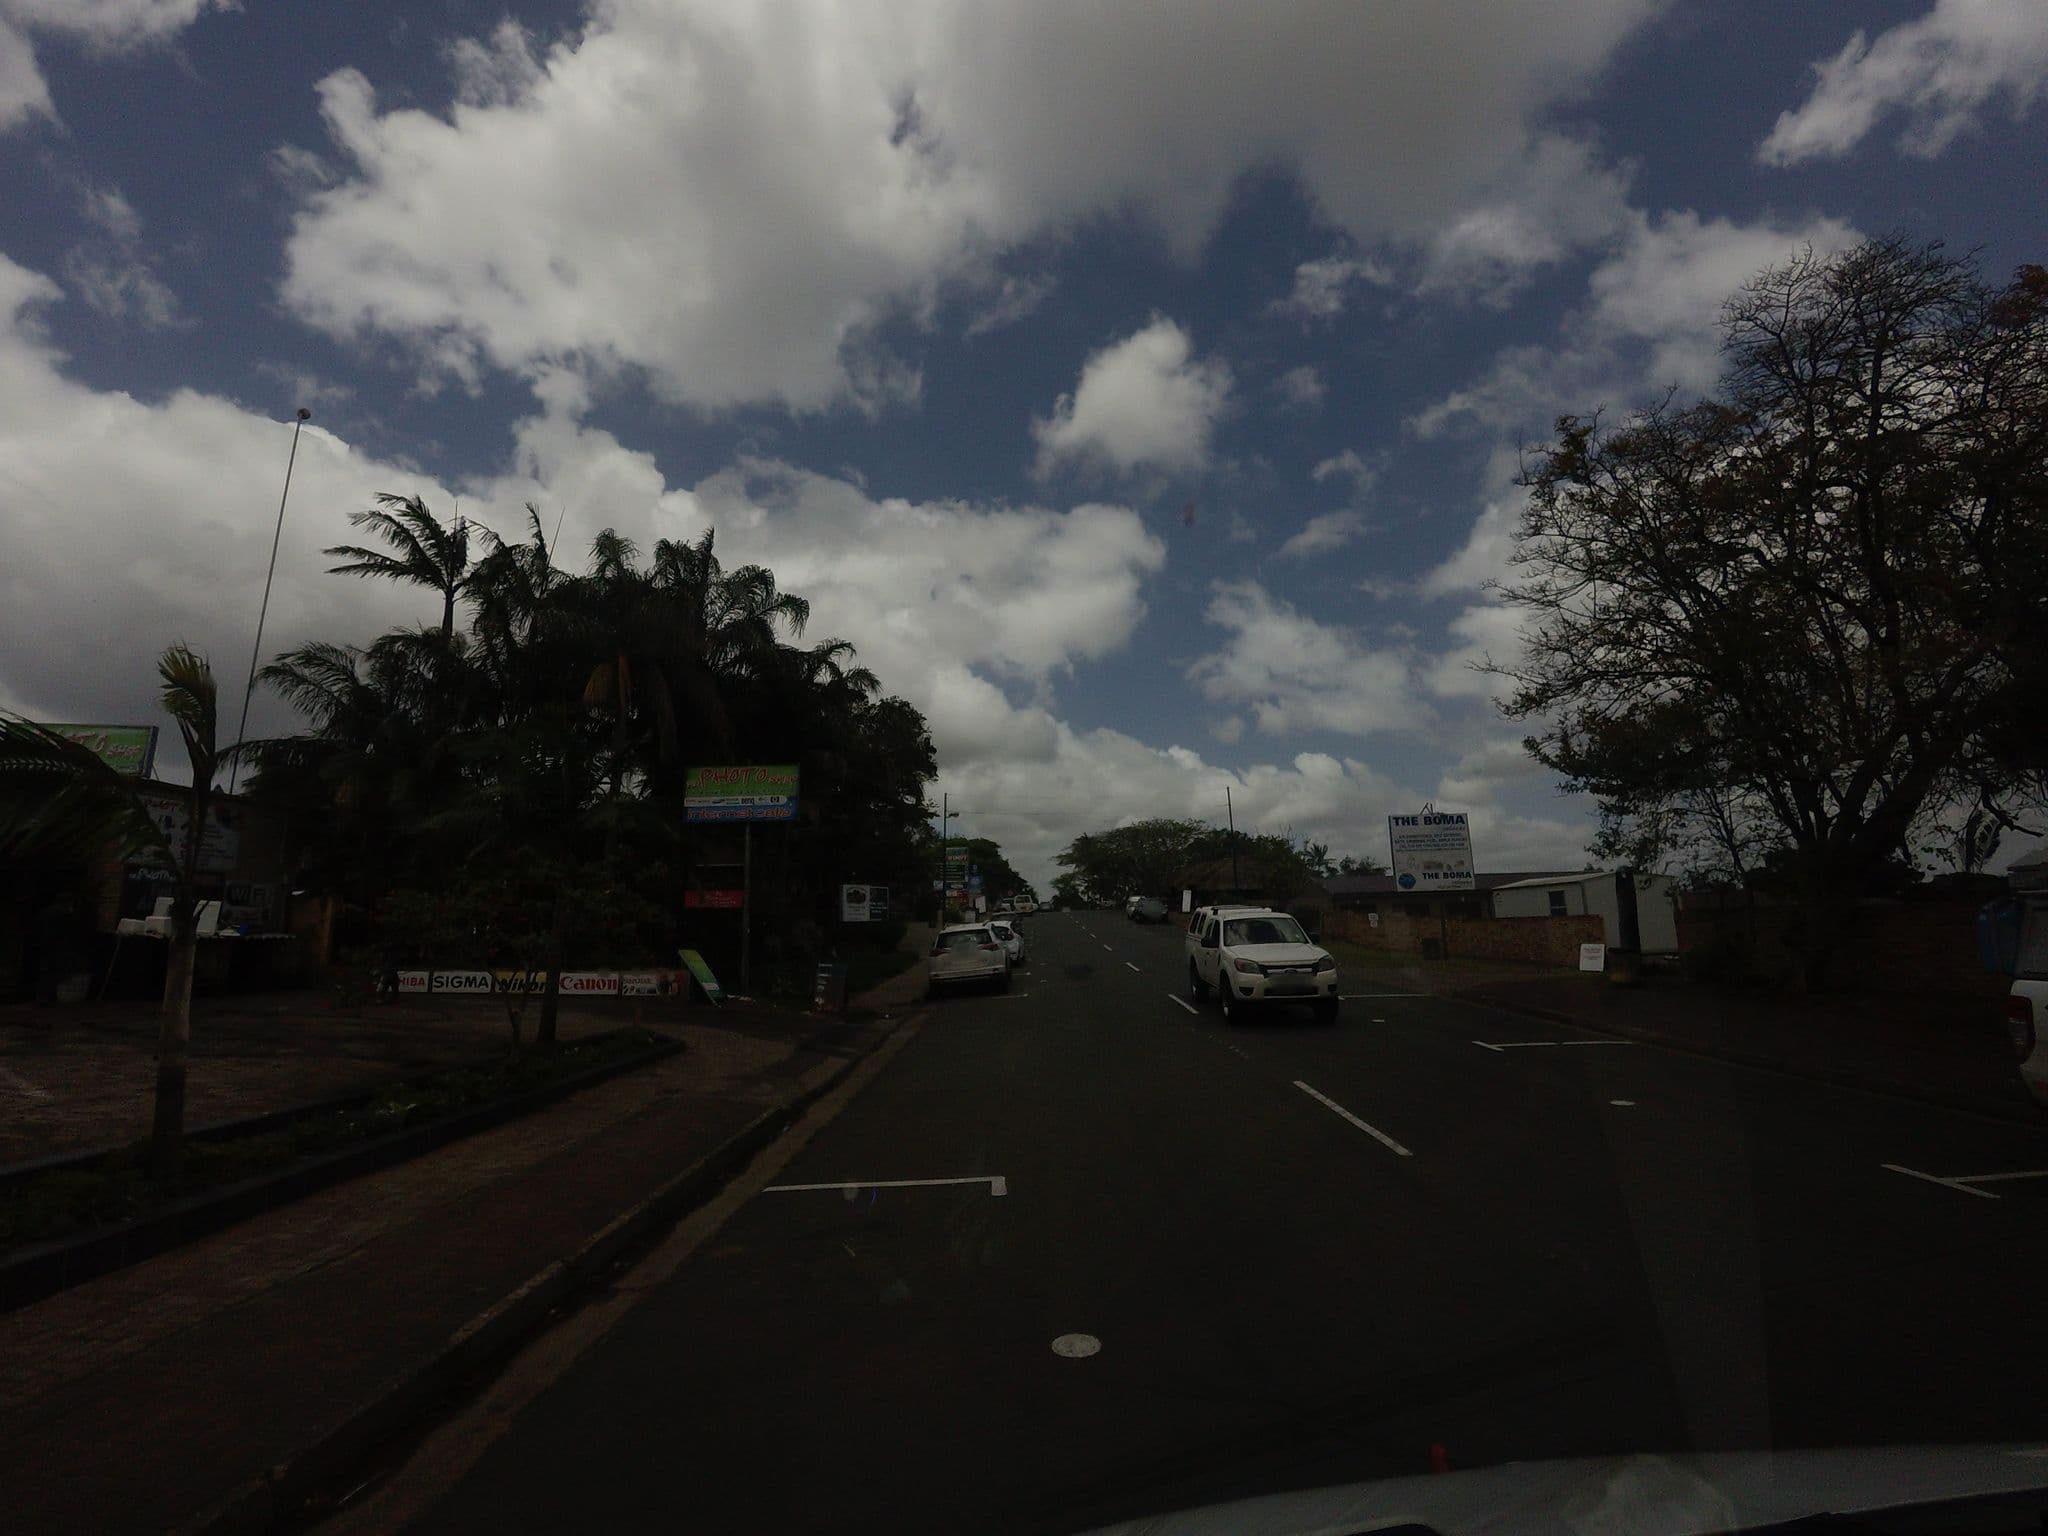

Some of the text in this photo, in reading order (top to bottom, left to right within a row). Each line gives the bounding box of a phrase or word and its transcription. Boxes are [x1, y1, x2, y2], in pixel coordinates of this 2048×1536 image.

[1392, 815, 1466, 826] THE BOMA
[1422, 871, 1473, 880] THE BOMA
[433, 975, 489, 989] SIGMA
[559, 976, 617, 990] Canon
